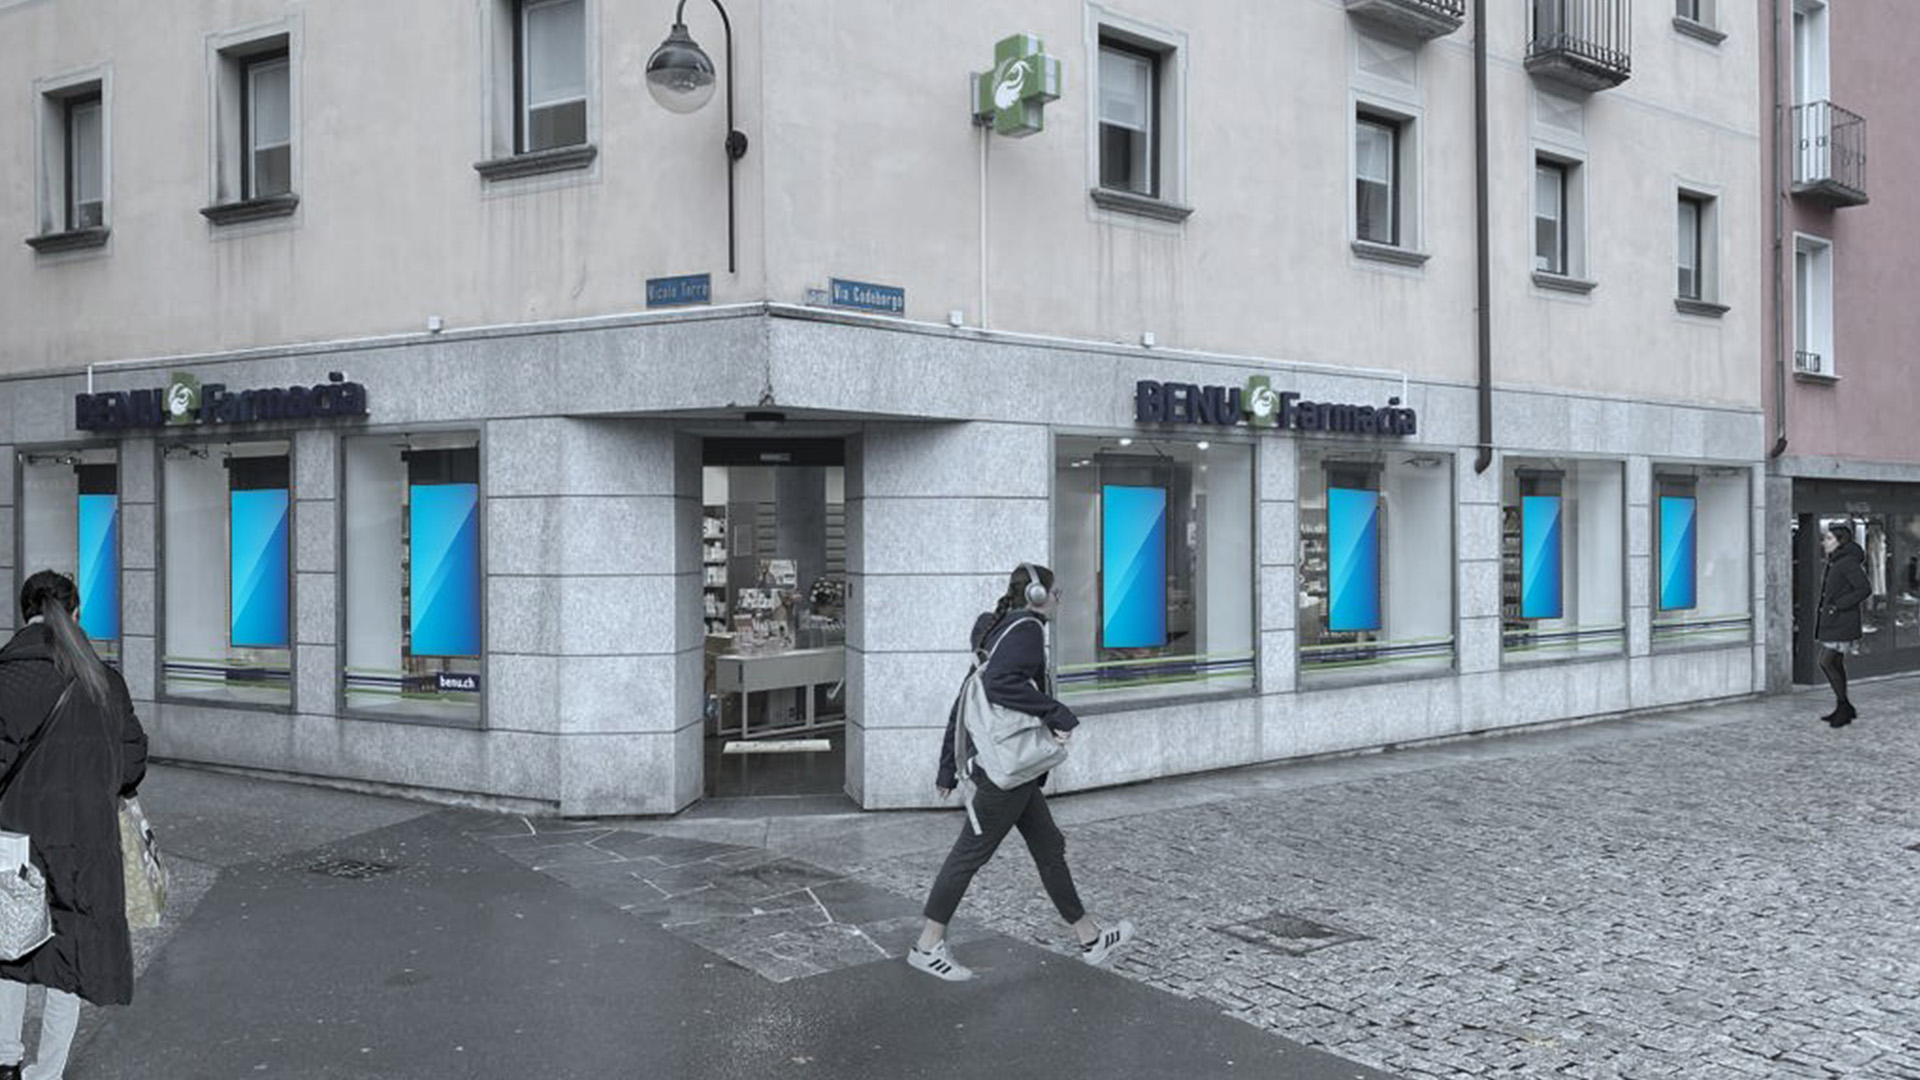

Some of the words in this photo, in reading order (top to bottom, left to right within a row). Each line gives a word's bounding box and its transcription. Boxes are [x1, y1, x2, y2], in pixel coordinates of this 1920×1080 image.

[834, 283, 849, 300] Via
[75, 388, 163, 431] BENU
[201, 371, 368, 423] Farmacia
[1136, 380, 1241, 426] BENU
[1279, 391, 1417, 435] Farmacia
[439, 674, 476, 689] benu.ch
